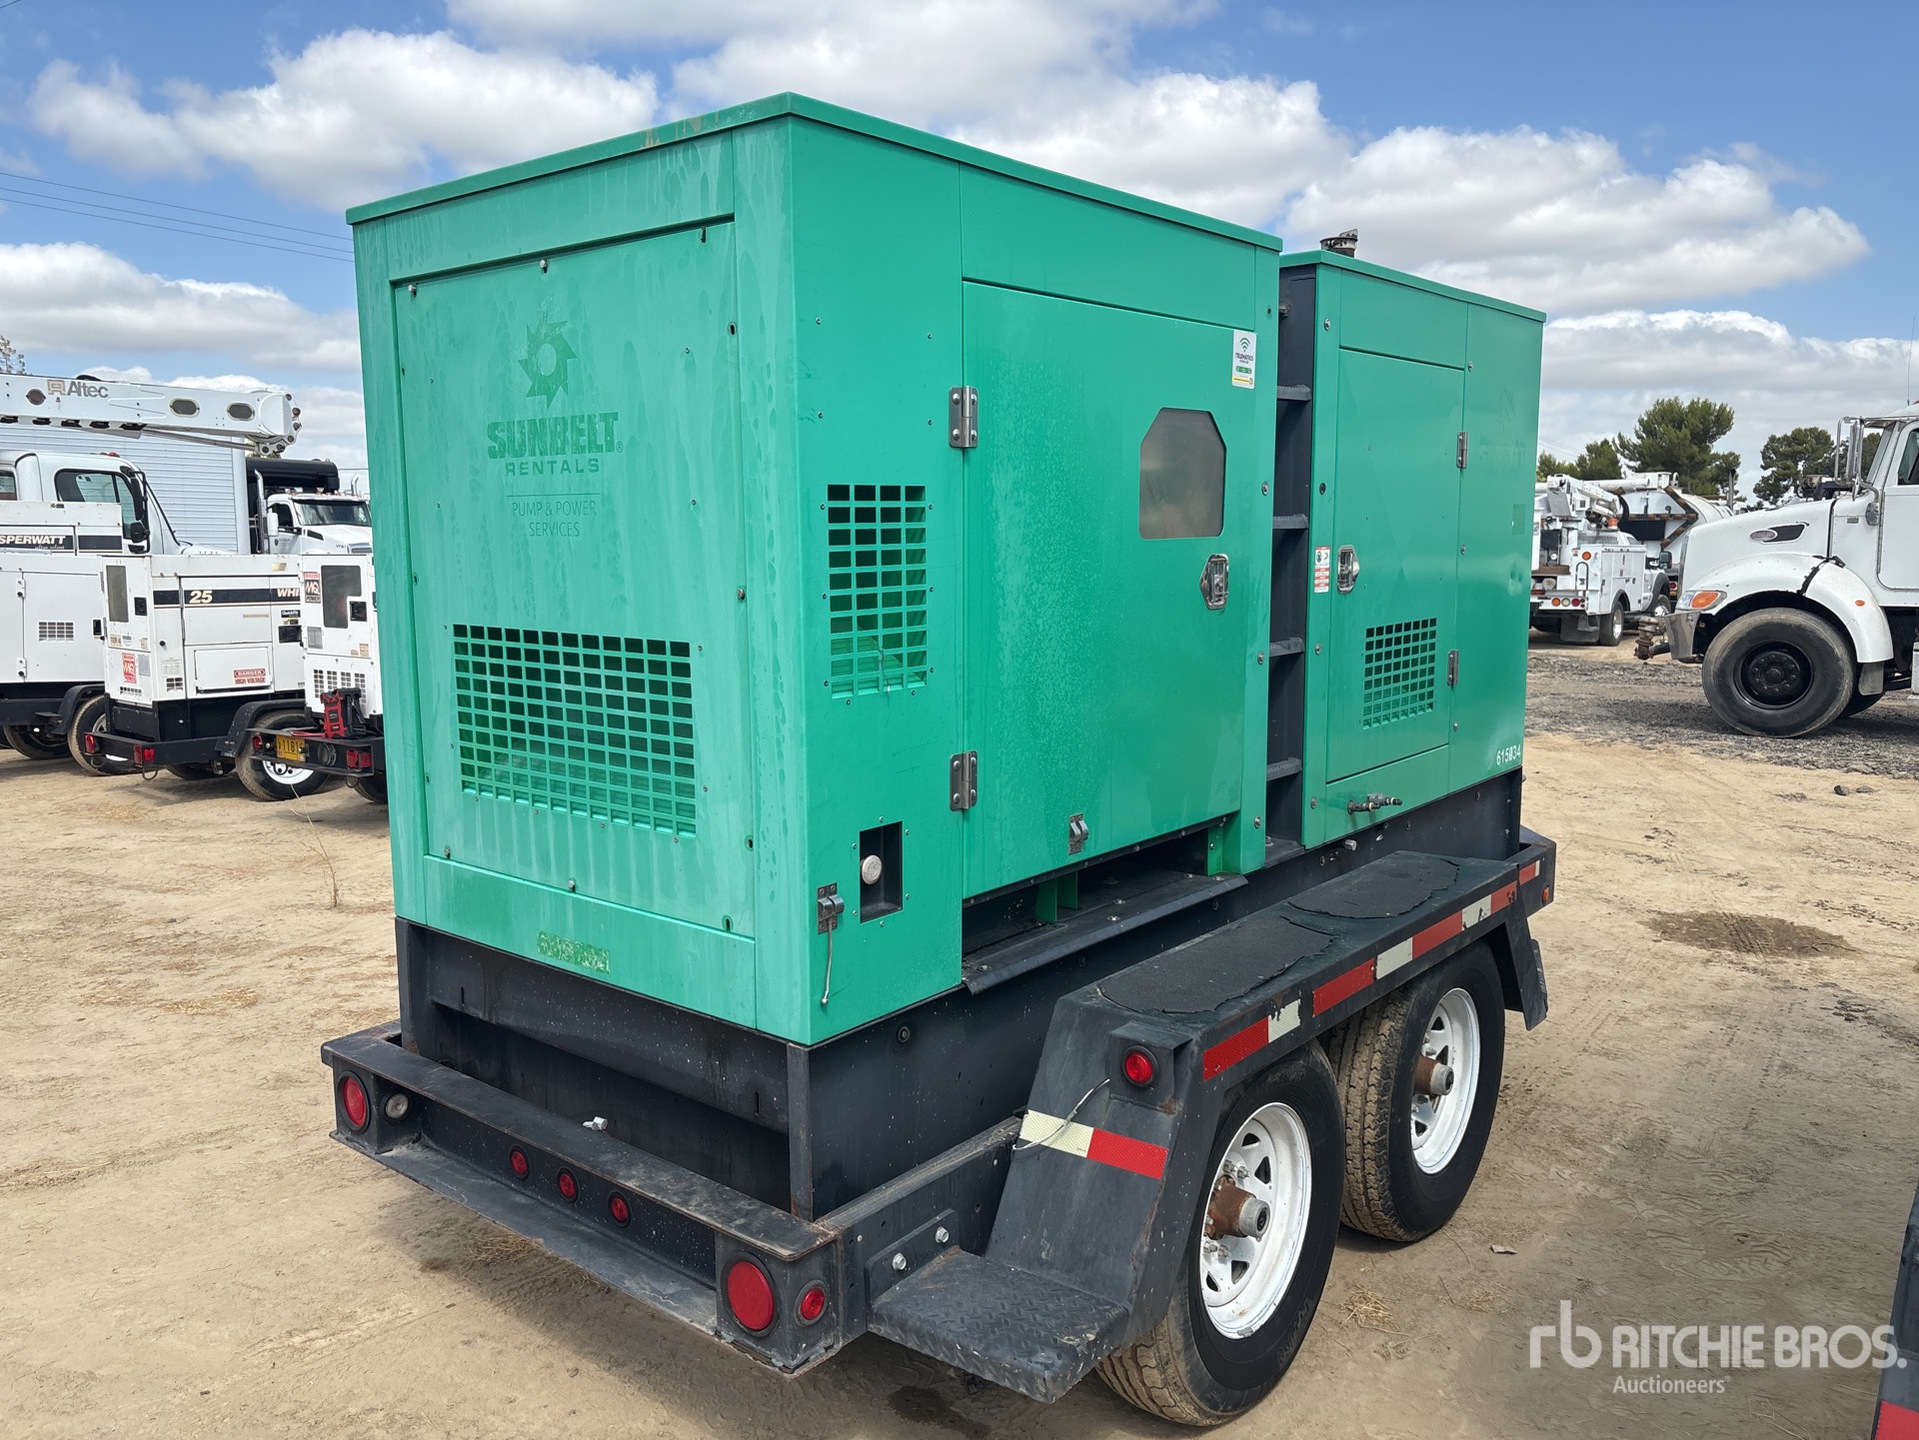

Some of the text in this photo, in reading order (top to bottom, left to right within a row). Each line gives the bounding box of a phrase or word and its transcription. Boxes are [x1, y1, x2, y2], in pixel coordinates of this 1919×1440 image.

[67, 381, 109, 398] Altec
[505, 457, 600, 477] RENTALS
[512, 500, 598, 517] PUMP & POWER
[529, 521, 580, 538] SERVICES
[189, 588, 301, 604] 25 WHI
